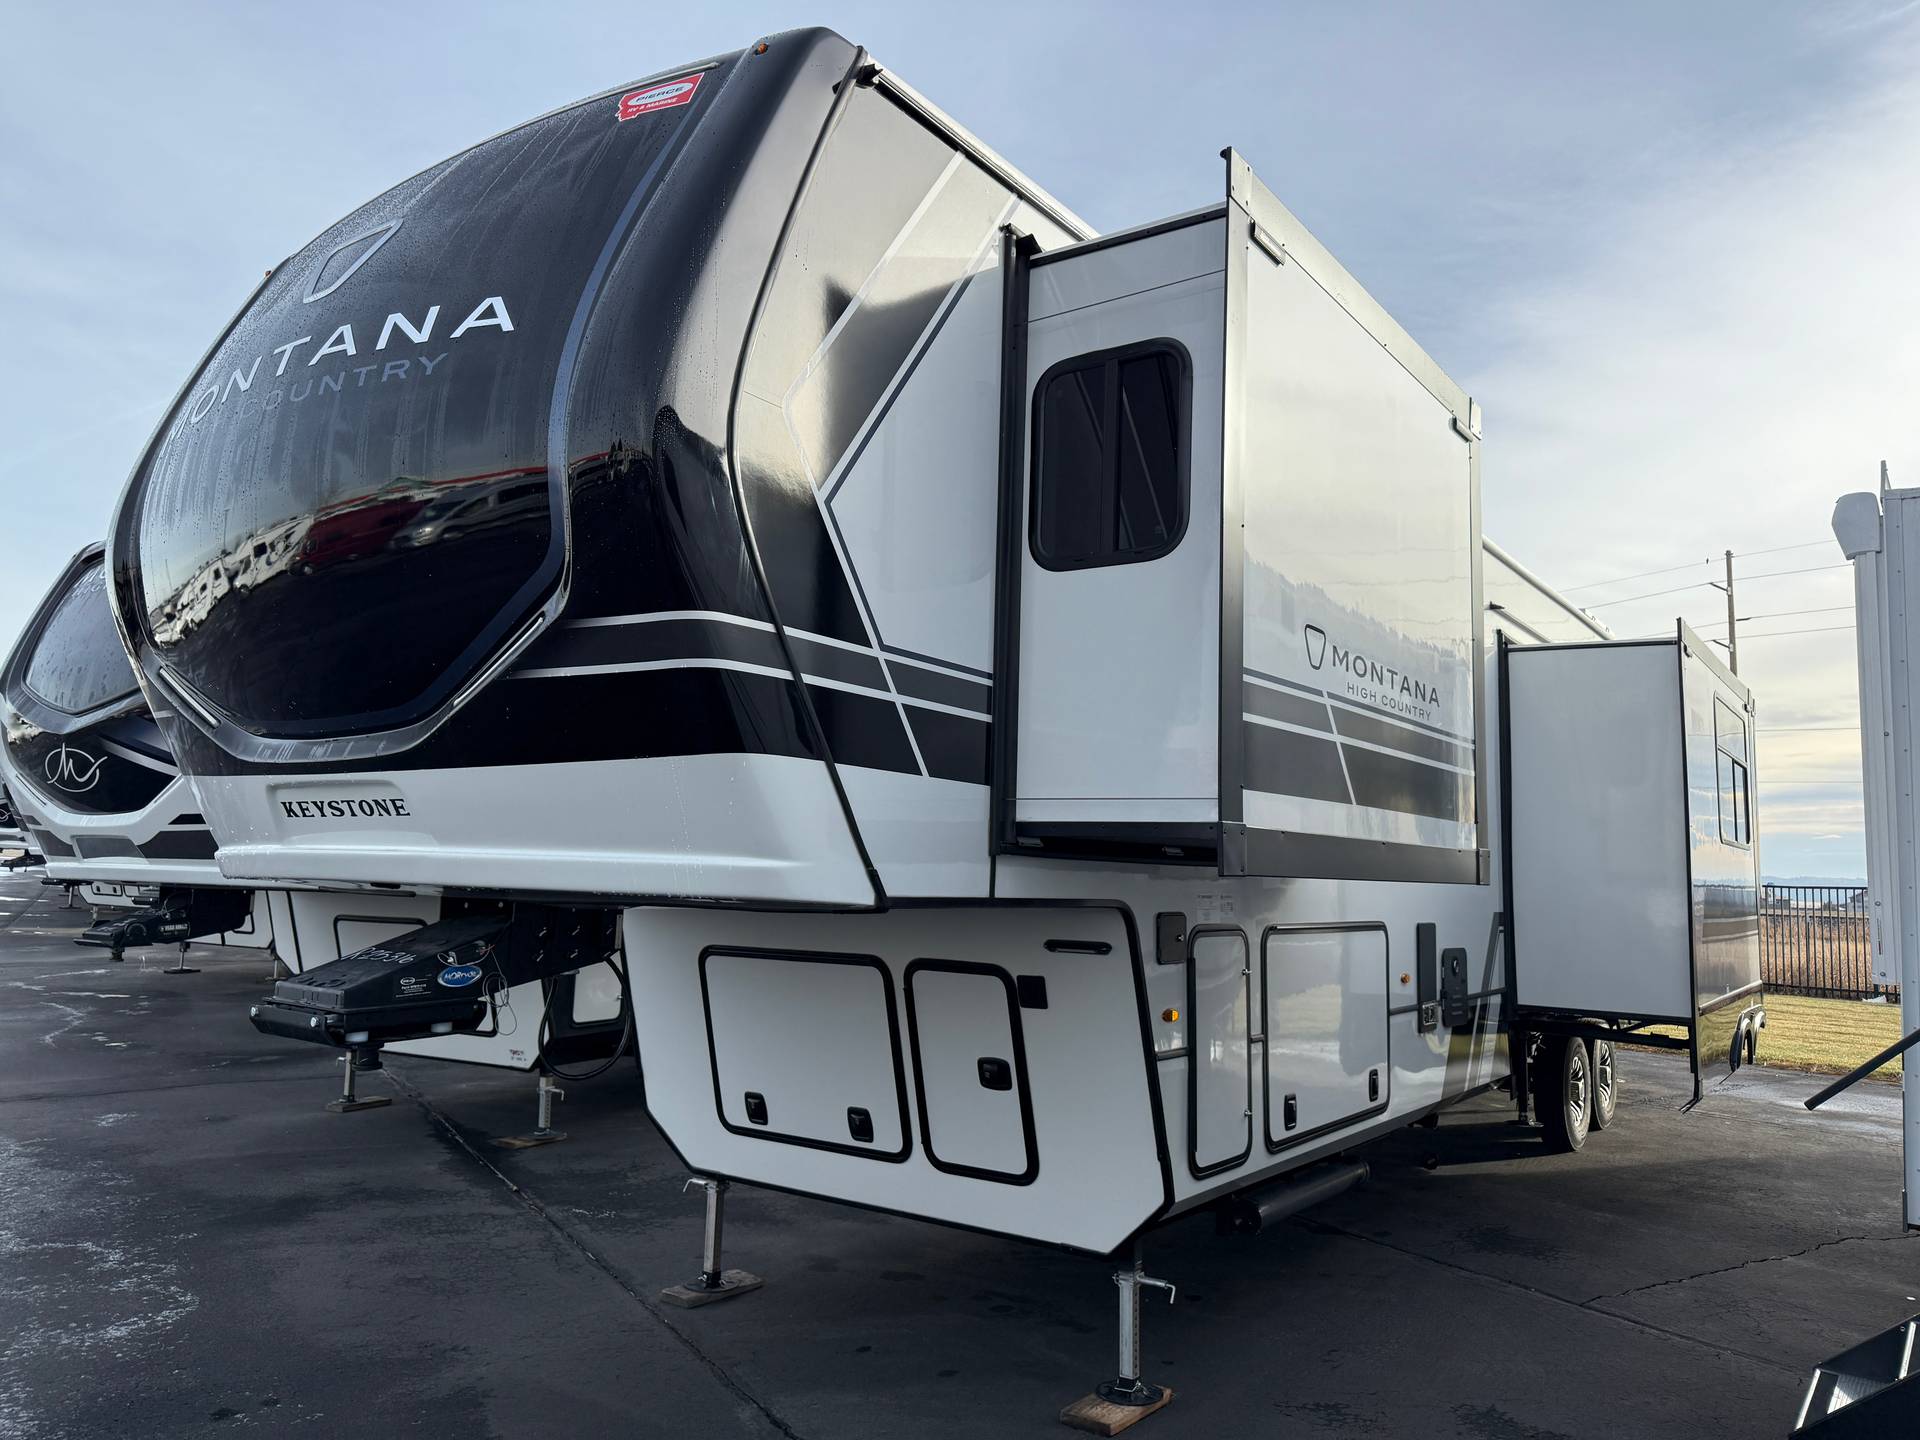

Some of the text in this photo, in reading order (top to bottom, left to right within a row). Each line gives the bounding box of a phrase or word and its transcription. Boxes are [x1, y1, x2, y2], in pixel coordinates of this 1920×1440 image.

[635, 86, 685, 102] PIERCE
[1332, 645, 1440, 708] MONTANA
[1346, 682, 1432, 721] HIGH COUNTRY
[280, 798, 411, 818] KEYSTONE
